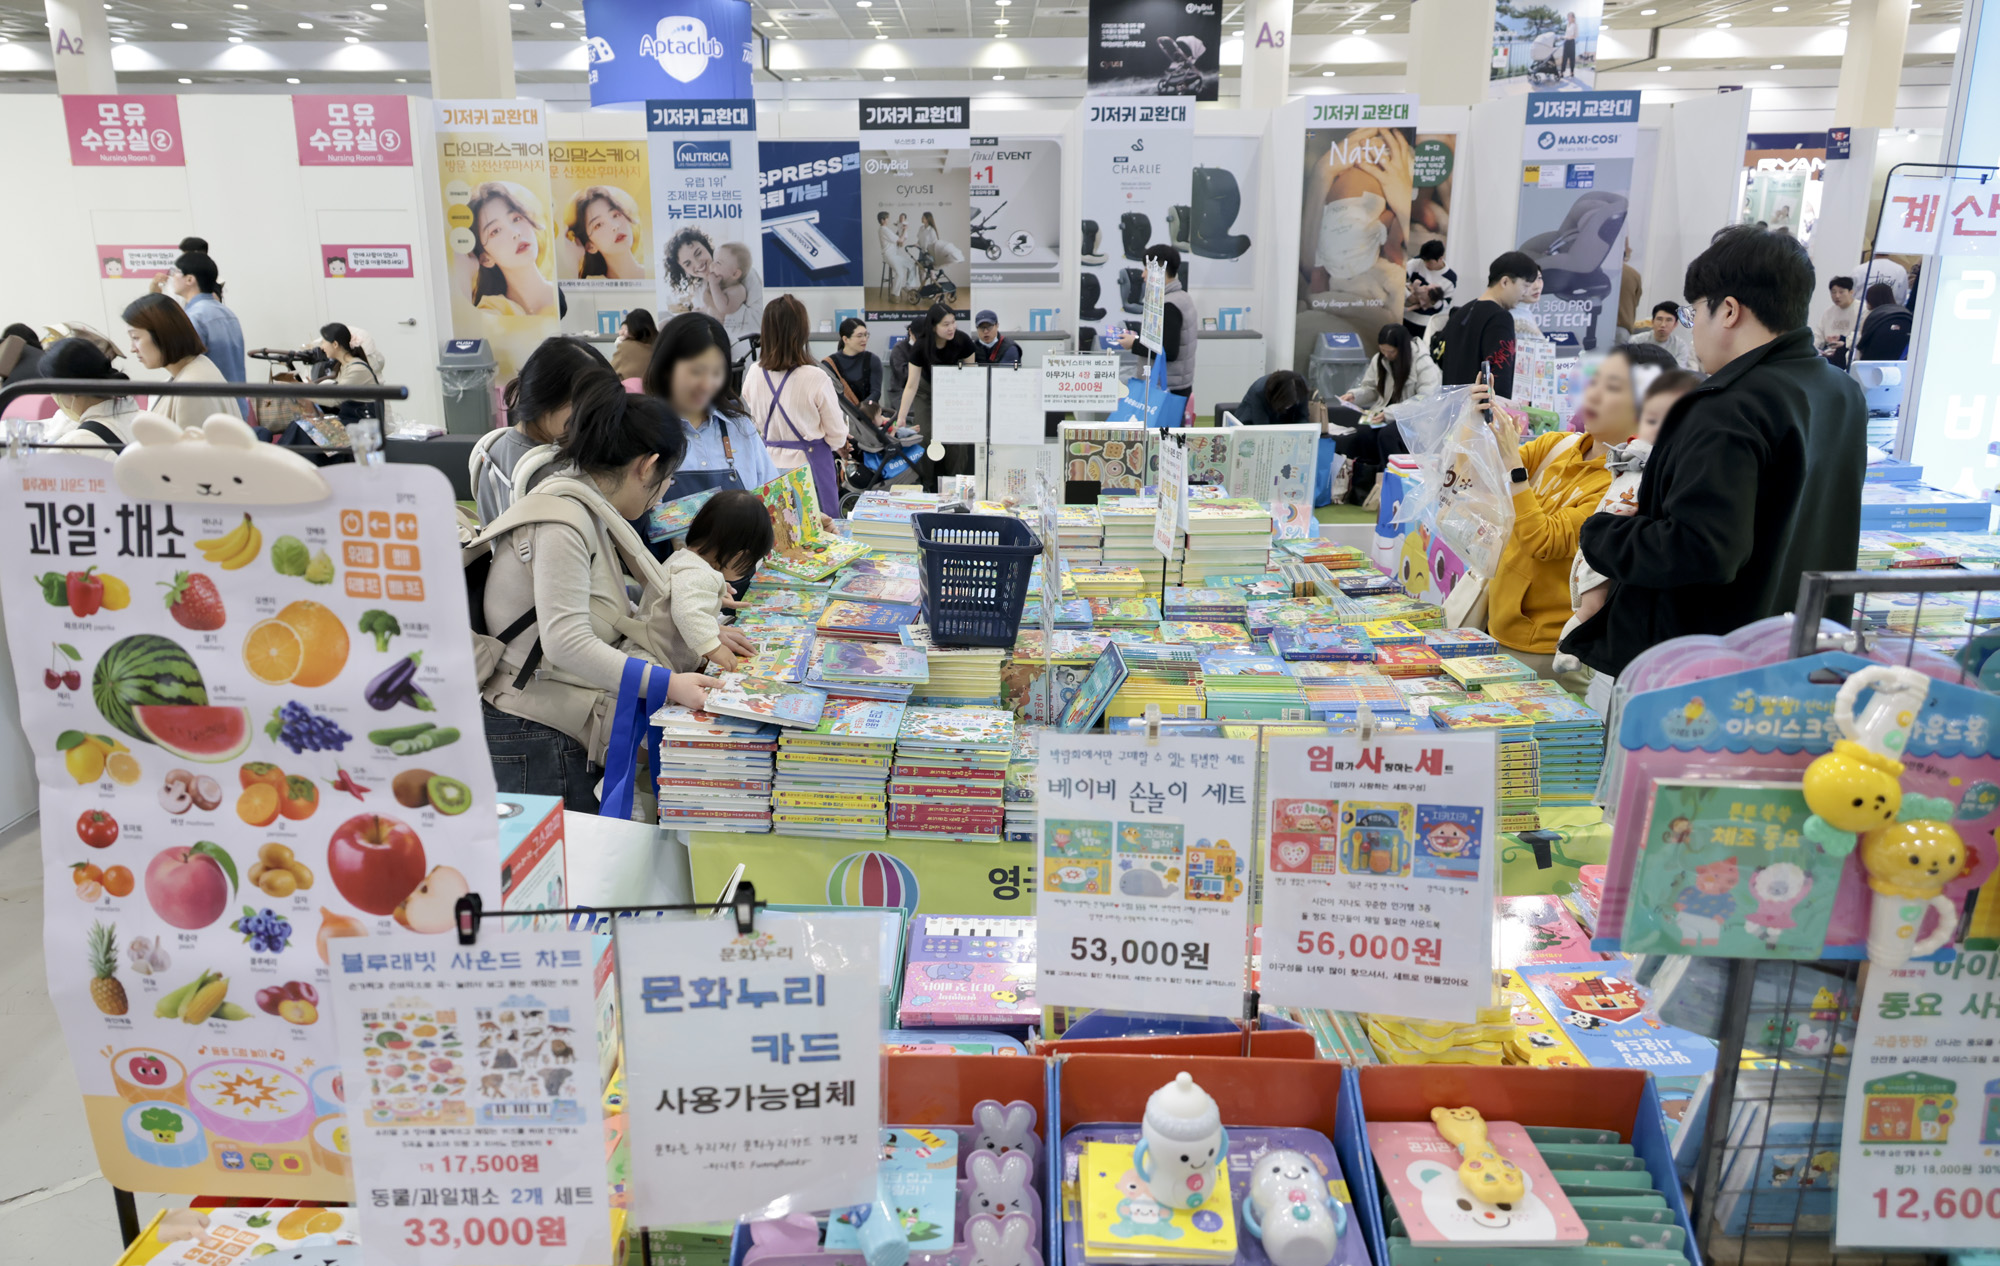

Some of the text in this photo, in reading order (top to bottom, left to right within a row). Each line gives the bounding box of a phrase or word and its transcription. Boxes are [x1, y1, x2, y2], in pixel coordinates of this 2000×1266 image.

[1256, 22, 1285, 48] A3
[56, 31, 85, 57] A2
[640, 34, 723, 58] Aptaclub
[98, 103, 146, 127] 모유
[328, 103, 376, 127] 모유
[866, 106, 962, 124] 기저귀 교환대
[1091, 106, 1186, 122] 기저귀 교환대
[1313, 104, 1409, 121] 기저귀 교환대
[1533, 99, 1632, 118] 기저귀 교환대
[443, 109, 538, 125] 기저귀 교환대
[653, 108, 748, 126] 기저귀 교환대
[444, 142, 544, 157] 다인맘스케어
[681, 152, 729, 162] NUTRICIA
[971, 151, 1032, 162] final EVENT
[100, 154, 148, 162] Nursing Room
[328, 154, 375, 162] Nursing Room
[880, 159, 908, 172] hyBrid
[471, 160, 545, 173] 산전산후마사지
[1112, 164, 1161, 174] CHARLIE
[685, 177, 704, 187] 유럽
[667, 190, 742, 200] 조제분유 브랜드
[787, 180, 828, 203] 가능!
[897, 185, 928, 197] cyrus
[668, 204, 742, 219] 뉴트리시아
[1312, 299, 1383, 308] Only diaper with 100%
[1547, 301, 1592, 312] 360 PRO
[1556, 314, 1591, 326] TECH
[1046, 371, 1116, 379] 아무거나 4장 골라서
[1058, 382, 1103, 392] 32,000원
[61, 478, 85, 492] 사운드
[89, 479, 107, 493] 차트
[349, 547, 373, 563] 우리말
[366, 579, 379, 594] 퀴즈
[406, 581, 421, 596] 퀴즈
[1050, 749, 1245, 769] 박람회에서만 구매할 수 있는 특별한 세트
[1359, 782, 1389, 791] 사랑하는
[1048, 778, 1246, 814] 베이비 손놀이 세트
[1711, 824, 1800, 851] 체조 동요
[1312, 898, 1431, 912] 시간이 지나도 꾸준한 인기템 3종
[1312, 913, 1440, 929] 정도 친구들이 제일 필요한 사운드북
[719, 946, 793, 962] 문화누리
[1070, 937, 1210, 970] 53,000원
[1297, 930, 1442, 966] 56,000원
[342, 950, 582, 973] 블루래빗 사운드 차트
[1269, 962, 1303, 972] 이구성을
[1307, 966, 1325, 974] 너무
[1329, 966, 1346, 975] 많이
[1393, 972, 1419, 982] 세트로
[1424, 974, 1469, 987] 만들었어요
[641, 975, 825, 1014] 문화누리
[1878, 992, 1942, 1019] 동요
[752, 1033, 840, 1064] 카드
[1611, 1039, 1672, 1053] 사운드북
[1935, 1039, 1961, 1047] 신나는
[1624, 1051, 1692, 1067] 말랑말랑
[1902, 1056, 1938, 1064] 실리콘의
[655, 1080, 855, 1114] 사용가능업체
[744, 1134, 858, 1151] 문화누리카드 가맹점
[419, 1154, 539, 1175] 1개 17,500원
[1895, 1165, 1972, 1175] 정가 18,000원
[371, 1187, 594, 1208] 동물/과일채소 2개 세트
[404, 1216, 567, 1249] 33,000원
